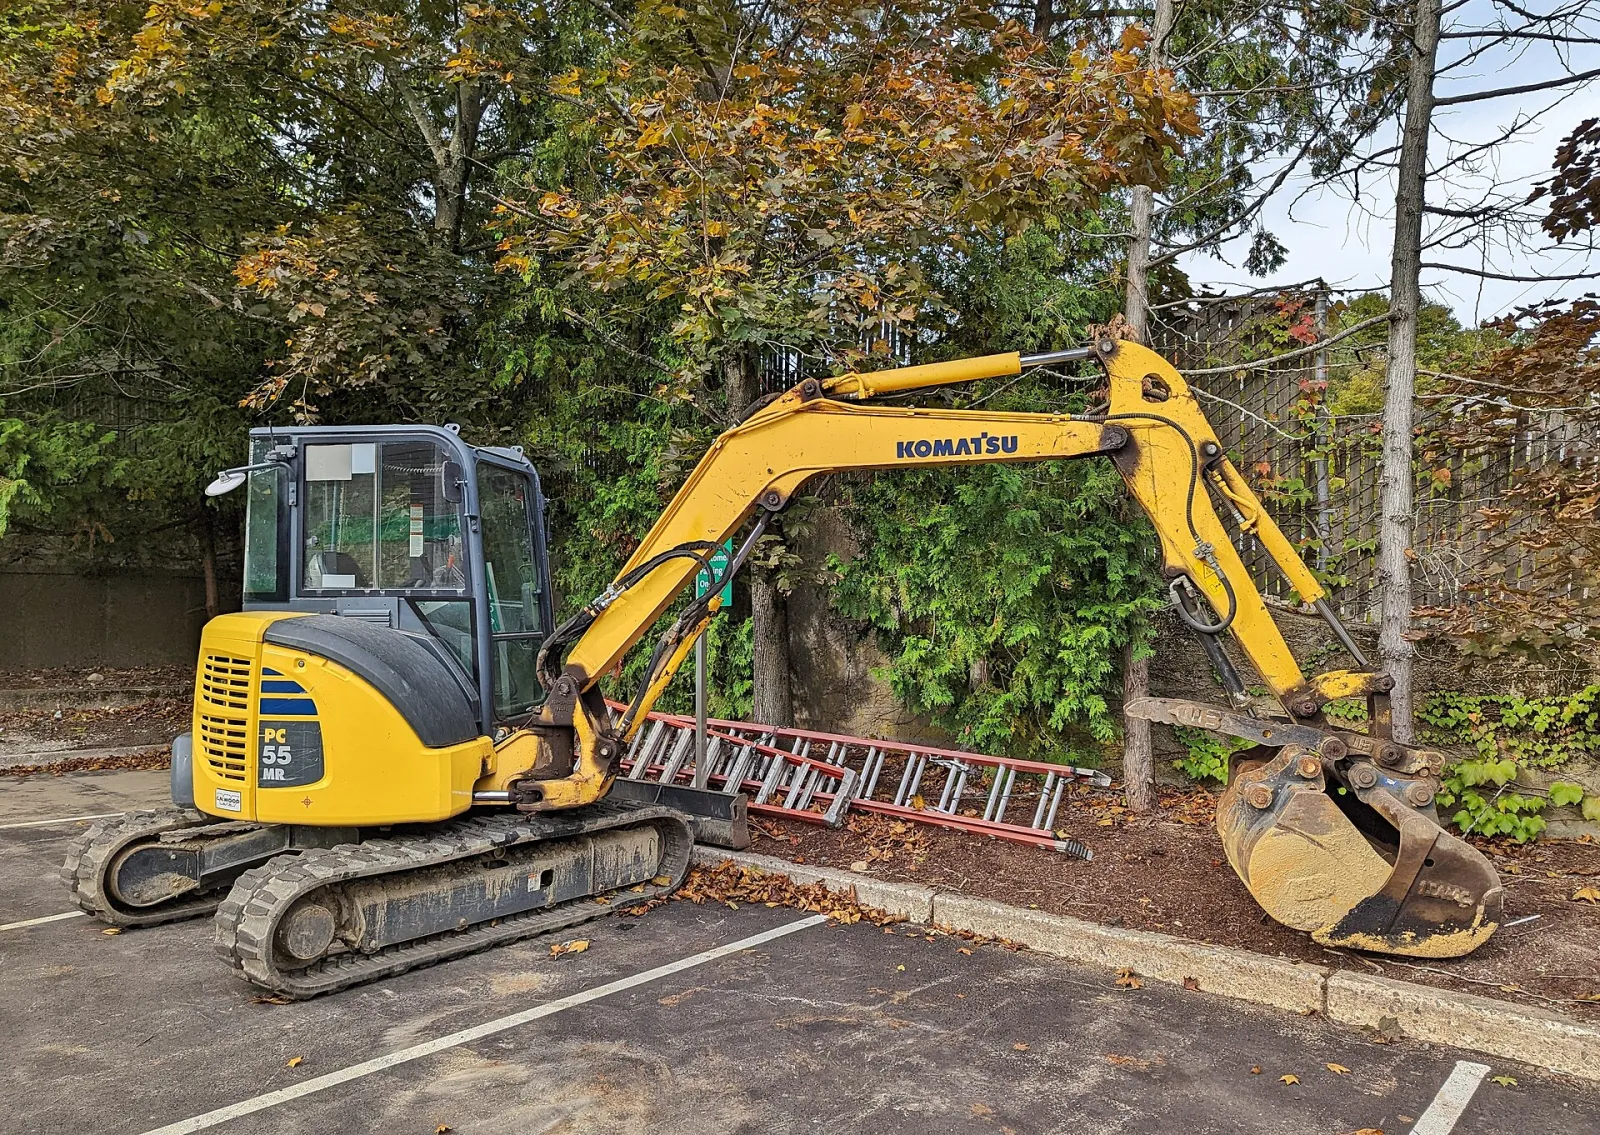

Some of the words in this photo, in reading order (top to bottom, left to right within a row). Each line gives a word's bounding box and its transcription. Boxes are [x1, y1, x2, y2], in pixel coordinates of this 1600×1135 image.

[896, 432, 1018, 458] KOMATSU
[264, 728, 287, 744] PC
[262, 745, 292, 765] 55
[262, 768, 286, 781] MR
